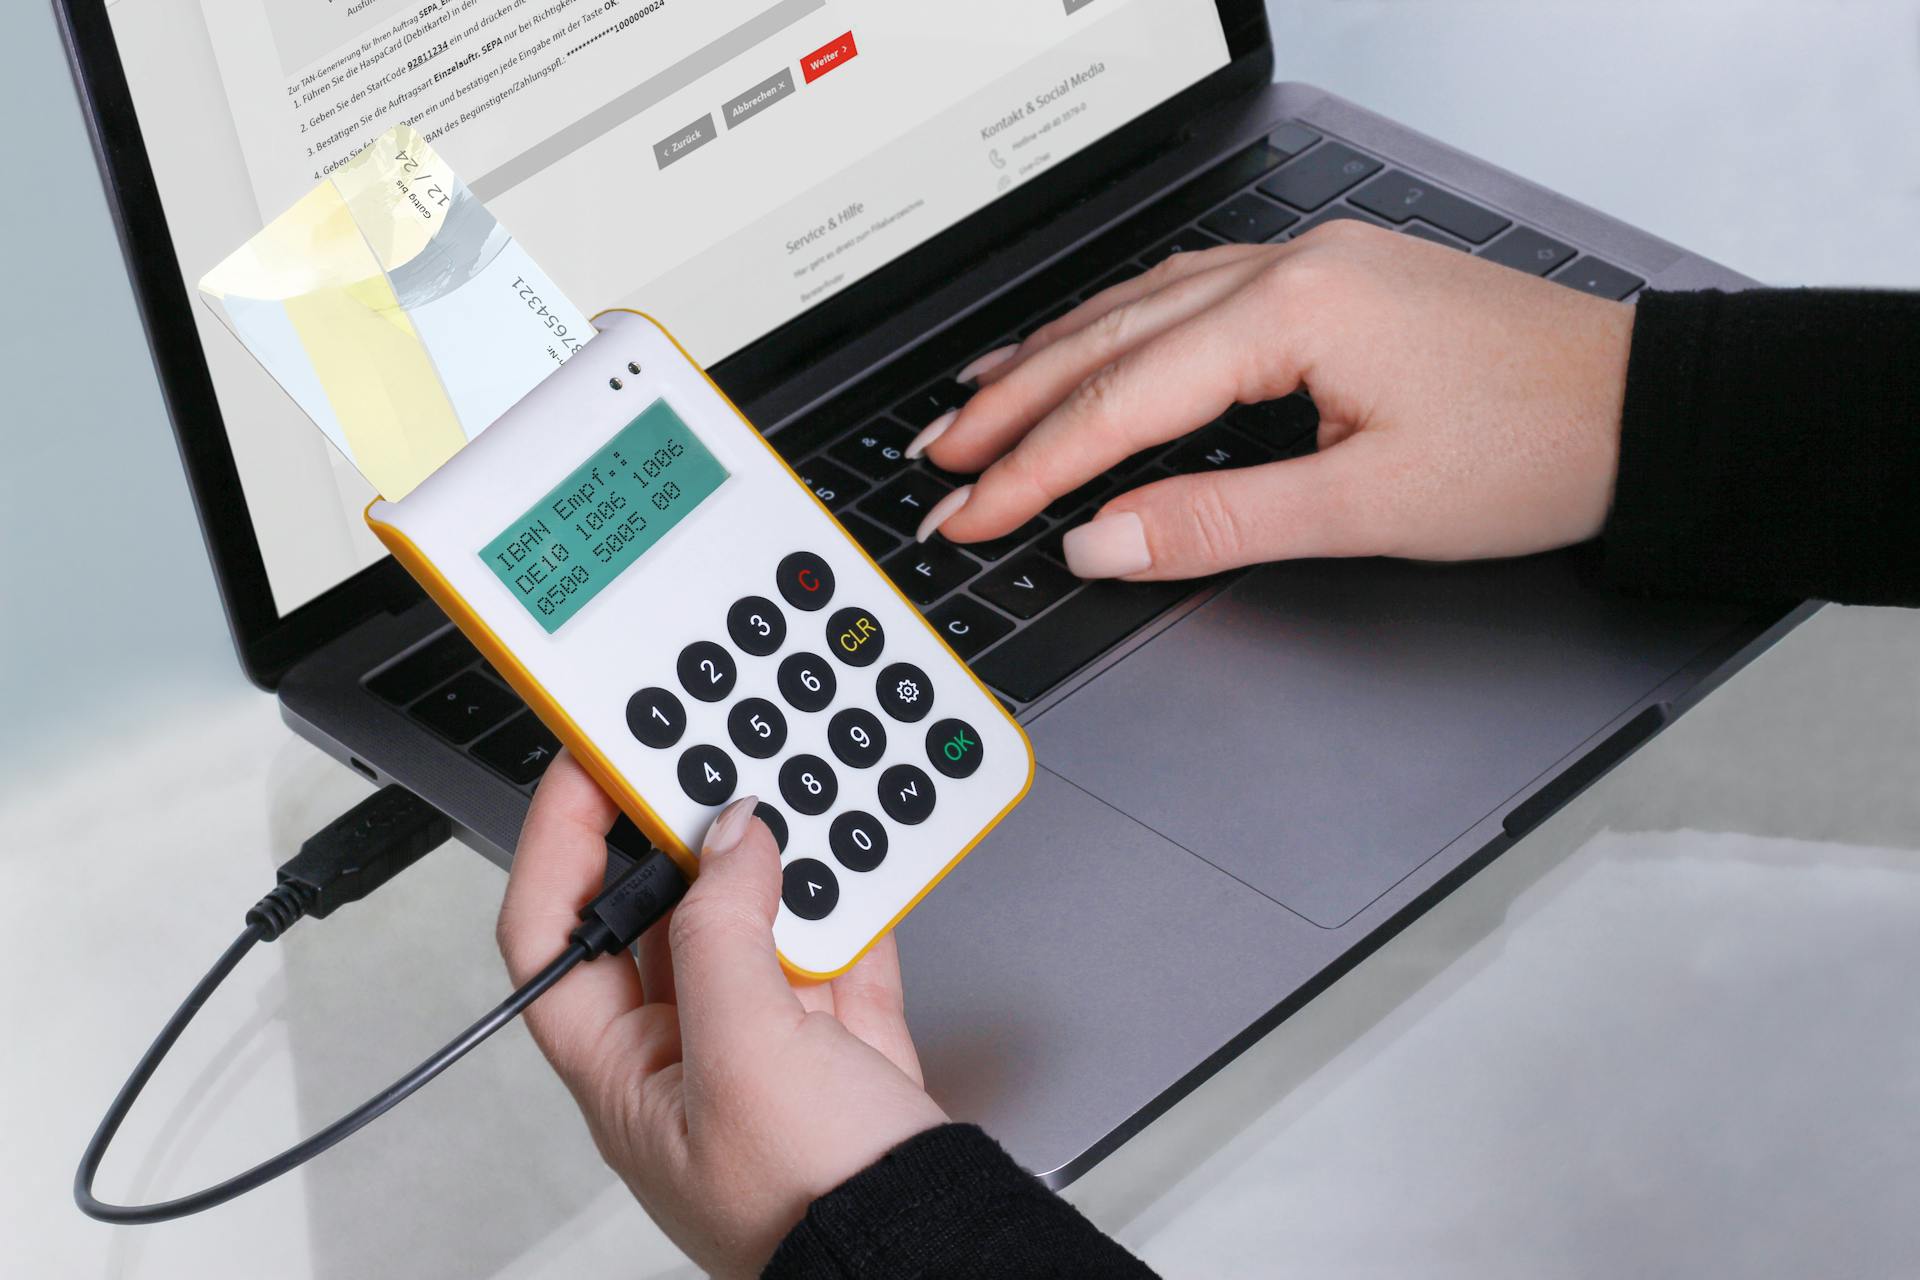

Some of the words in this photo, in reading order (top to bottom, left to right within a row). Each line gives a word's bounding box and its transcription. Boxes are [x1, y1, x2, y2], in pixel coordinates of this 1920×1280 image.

[288, 84, 300, 96] Zur
[300, 49, 360, 88] TAN-Generierung
[360, 42, 372, 54] für
[372, 30, 392, 46] Ihren
[392, 16, 418, 34] Auftrag
[294, 100, 302, 108] 1.
[302, 82, 331, 104] Führen
[331, 74, 344, 88] Sie
[345, 64, 358, 78] die
[360, 40, 403, 70] HaspaCard
[403, 11, 450, 46] (Debitkarte)
[451, 8, 460, 16] in
[810, 48, 839, 71] Weiter
[300, 124, 309, 134] 2.
[309, 107, 336, 128] Geben
[336, 98, 350, 112] Sie
[350, 88, 366, 104] den
[366, 66, 407, 94] StartCode
[407, 41, 449, 72] 92811234
[449, 32, 463, 46] ein
[464, 22, 480, 38] und
[480, 5, 512, 28] drücken
[306, 148, 316, 158] 3.
[316, 123, 360, 152] Bestätigen
[360, 113, 373, 128] Sie
[374, 104, 388, 119] die
[388, 78, 434, 110] Auftragsart
[433, 51, 481, 83] Einzelauftr.
[481, 37, 504, 56] SEPA
[504, 29, 518, 42] nur
[518, 19, 532, 33] bei
[314, 171, 322, 180] 4.
[322, 156, 349, 175] Geben
[424, 104, 439, 118] ein
[439, 93, 456, 108] und
[456, 65, 499, 98] bestätigen
[499, 57, 518, 74] jede
[518, 38, 552, 61] Eingabe
[552, 28, 566, 42] mit
[567, 20, 581, 32] der
[582, 7, 603, 24] Taste
[732, 86, 777, 118] Abbrechen
[980, 107, 1024, 141] Kontakt
[1025, 101, 1036, 116] &
[1036, 79, 1070, 110] Social
[1070, 61, 1106, 89] Media
[444, 116, 460, 132] des
[671, 129, 702, 153] Zurück
[395, 150, 418, 172] 24
[396, 180, 409, 194] bis
[428, 184, 450, 206] 12
[408, 194, 432, 218] Gültig
[785, 224, 826, 255] Service
[827, 217, 838, 231] &
[838, 202, 864, 225] Hilfe
[882, 447, 900, 460] 6
[1207, 448, 1231, 464] M
[816, 487, 836, 500] 5
[900, 494, 920, 507] T
[515, 543, 570, 595] DE10
[576, 492, 626, 541] 1006
[633, 438, 684, 489] 1006
[496, 519, 552, 571] IBAN
[536, 564, 590, 615] 0500
[592, 510, 648, 563] 5005
[651, 481, 681, 510] 00
[799, 569, 820, 593] C
[916, 562, 932, 576] F
[1014, 576, 1034, 592] V
[750, 614, 771, 637] 3
[840, 617, 876, 654] CLR
[948, 620, 970, 636] C
[700, 659, 723, 684] 2
[800, 670, 821, 693] 6
[652, 706, 670, 727] 1
[749, 714, 772, 739] 5
[849, 726, 870, 749] 9
[943, 730, 974, 762] OK
[703, 762, 722, 784] 4
[801, 772, 823, 795] 8
[852, 828, 872, 852] 0
